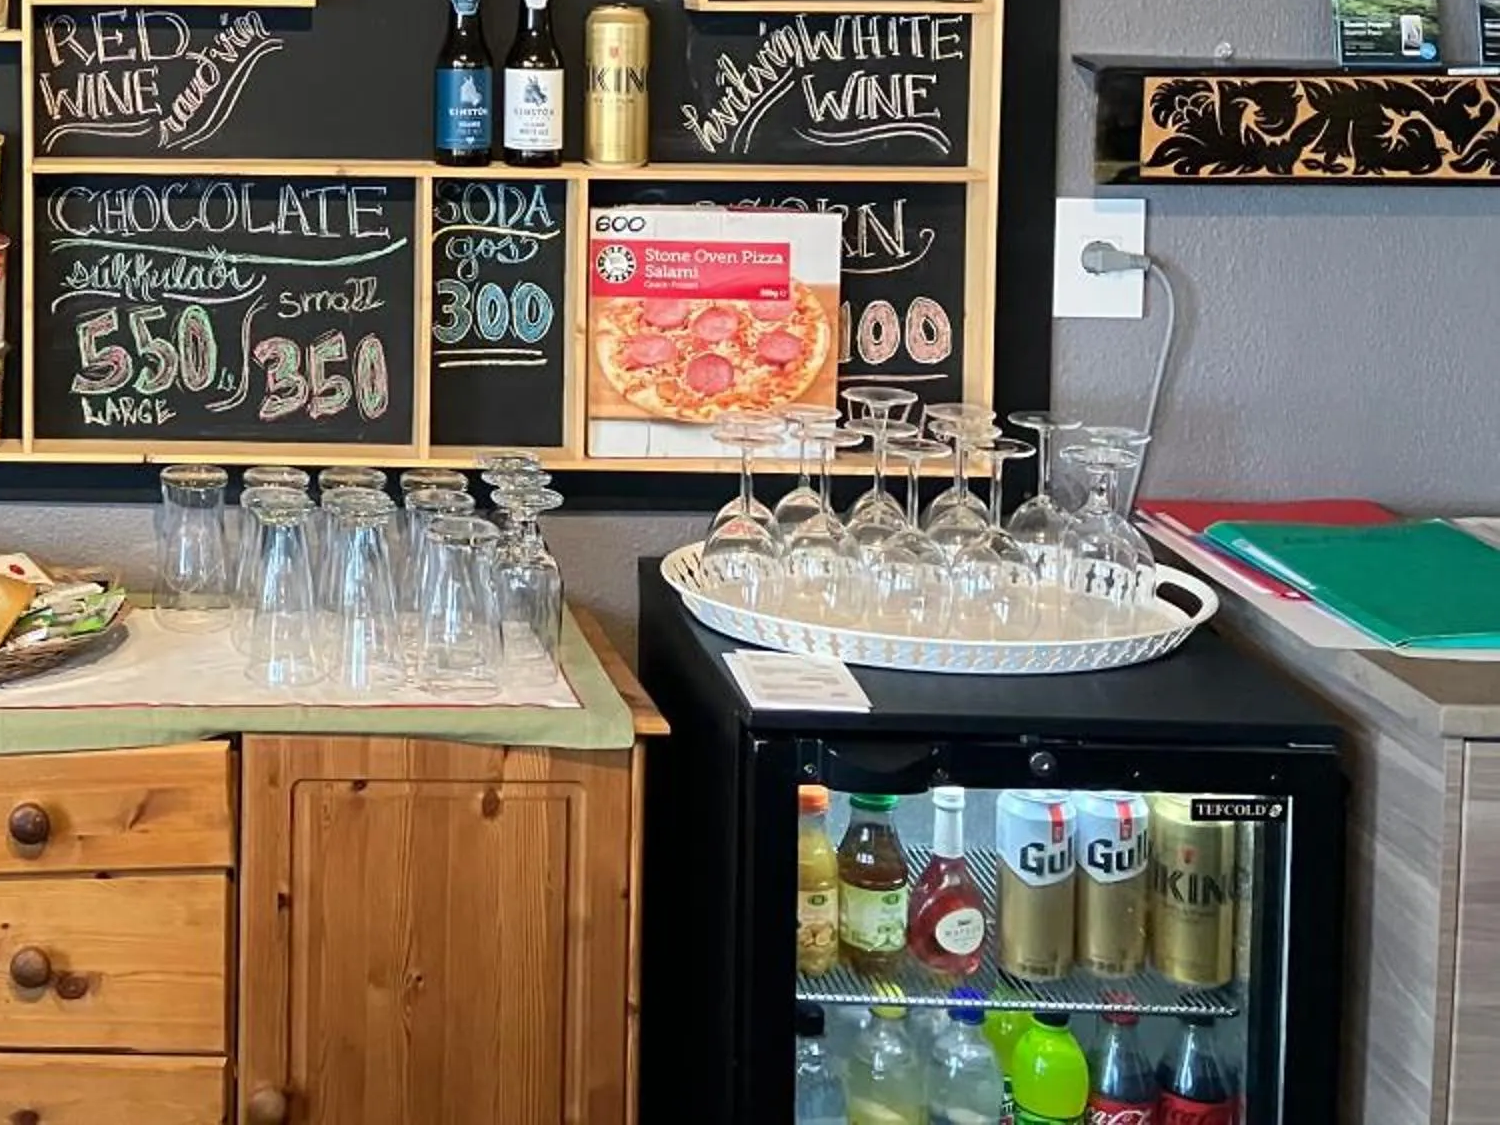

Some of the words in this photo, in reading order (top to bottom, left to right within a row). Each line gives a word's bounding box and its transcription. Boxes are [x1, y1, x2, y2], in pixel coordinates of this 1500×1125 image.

[43, 8, 191, 68] RED
[795, 13, 965, 63] WHITE
[39, 63, 162, 120] WINE
[801, 70, 941, 122] WINE
[47, 182, 391, 239] CHOCOLATE
[433, 179, 556, 228] SODA
[594, 215, 648, 233] 600
[445, 234, 540, 283] gos
[645, 248, 691, 263] Stone
[694, 249, 738, 264] Oven
[742, 251, 784, 265] Pizza
[645, 264, 699, 280] Salami
[277, 276, 386, 319] small
[432, 278, 554, 344] 300
[70, 304, 218, 395] 550
[252, 328, 390, 422] 350
[81, 397, 177, 426] LARGE
[1196, 803, 1266, 817] TEFCOLD
